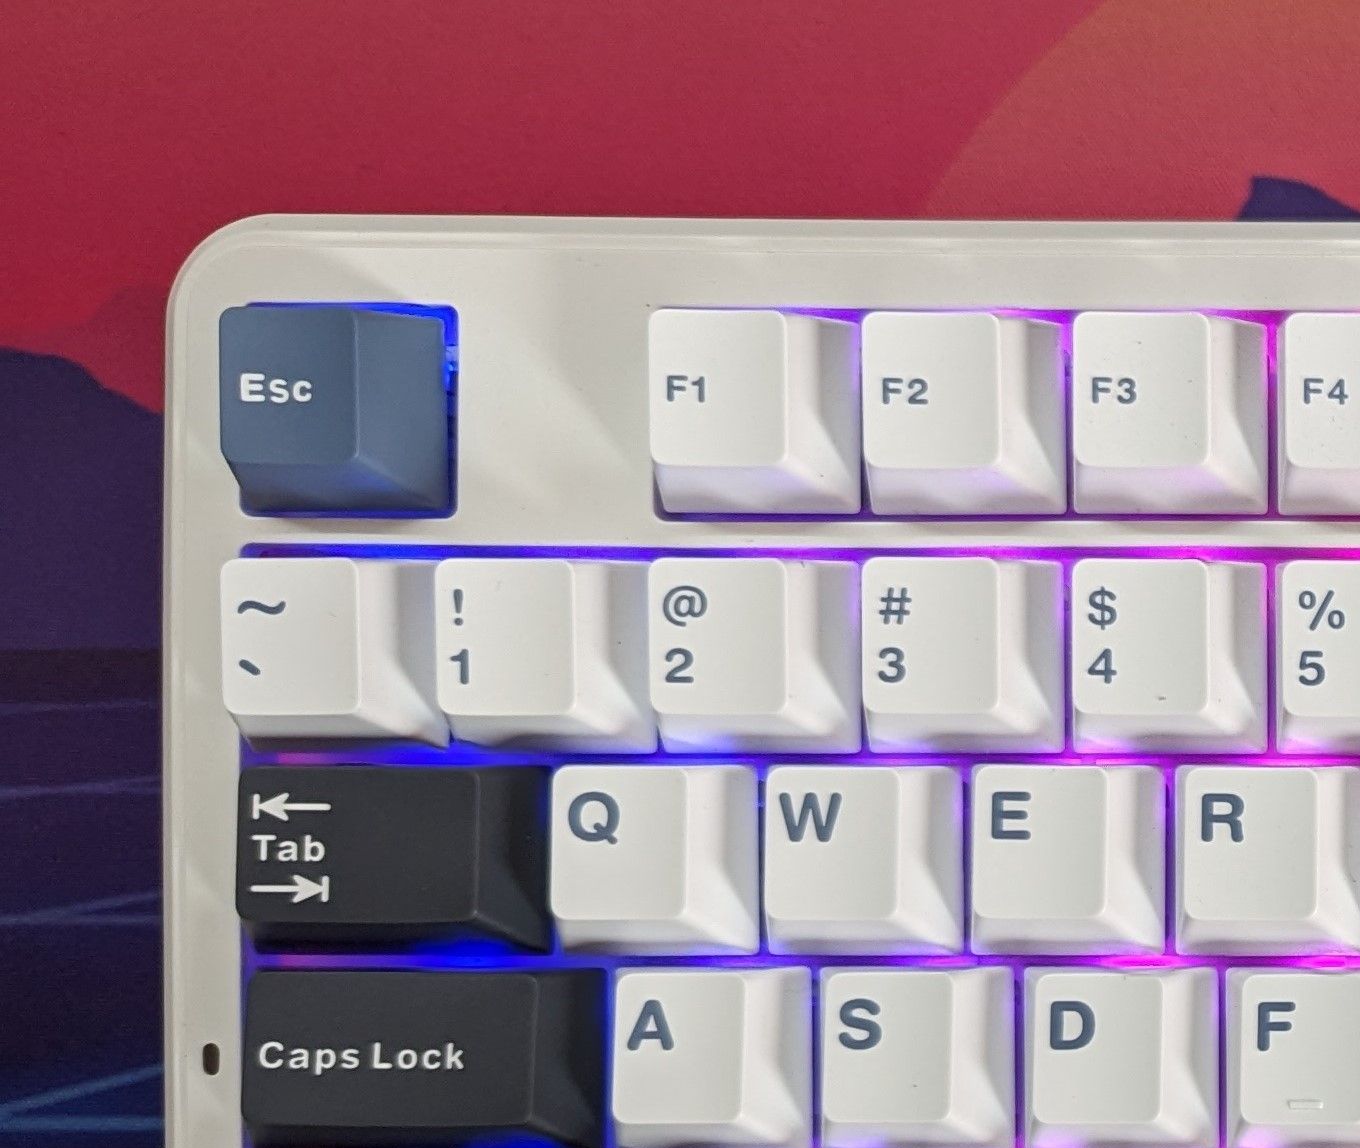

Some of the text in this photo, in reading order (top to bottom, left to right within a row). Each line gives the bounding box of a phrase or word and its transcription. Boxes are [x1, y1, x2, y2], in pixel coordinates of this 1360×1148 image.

[240, 373, 311, 403] Esc
[667, 375, 704, 402] F1
[882, 378, 928, 404] F2
[1092, 377, 1136, 404] F3
[1304, 378, 1348, 404] F4
[238, 601, 285, 615] ~
[453, 589, 463, 625] !
[663, 586, 707, 626] @
[879, 588, 911, 624] #
[1088, 587, 1116, 630] $
[1299, 590, 1344, 631] %
[450, 649, 469, 684] 1
[665, 648, 693, 683] 2
[878, 647, 905, 683] 3
[1088, 649, 1116, 683] 4
[1299, 651, 1324, 686] 5
[568, 792, 619, 844] Q
[779, 793, 841, 842] W
[991, 792, 1030, 840] E
[1201, 793, 1244, 842] R
[252, 835, 324, 861] Tab
[627, 1000, 673, 1050] A
[839, 999, 881, 1050] S
[1050, 1001, 1095, 1050] D
[1257, 1002, 1295, 1051] F
[259, 1042, 463, 1075] Caps Lock
